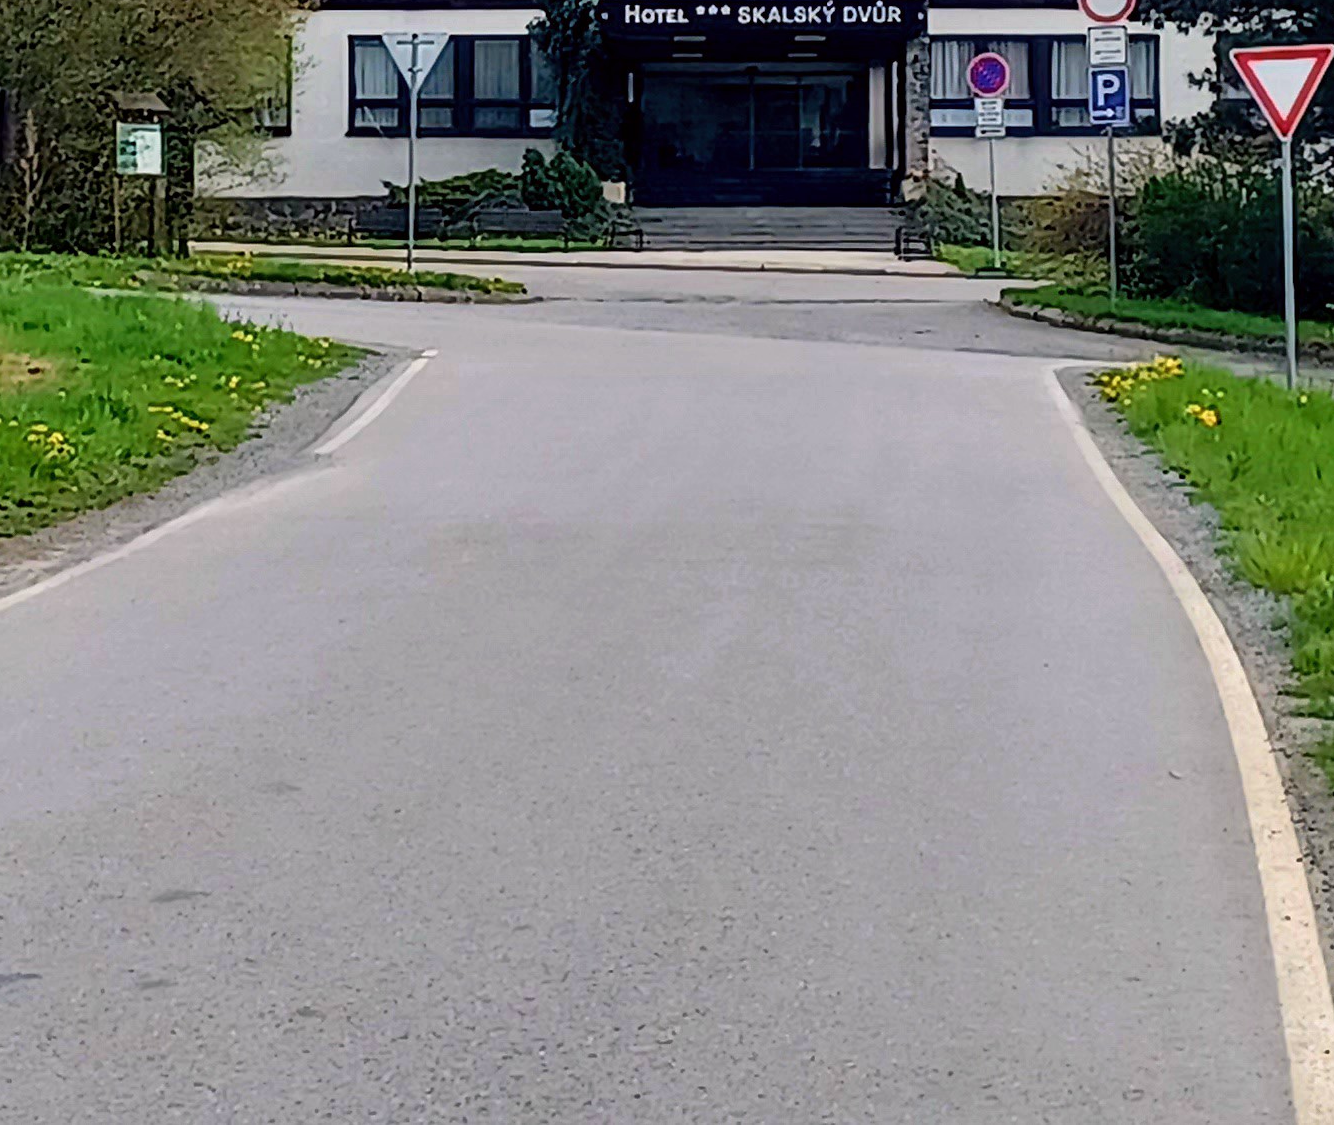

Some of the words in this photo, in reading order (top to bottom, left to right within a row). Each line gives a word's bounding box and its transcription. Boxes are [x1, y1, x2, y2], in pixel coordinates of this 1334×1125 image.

[738, 0, 836, 24] SKALSKÝ
[843, 0, 902, 24] DVŮR
[1096, 74, 1121, 107] P
